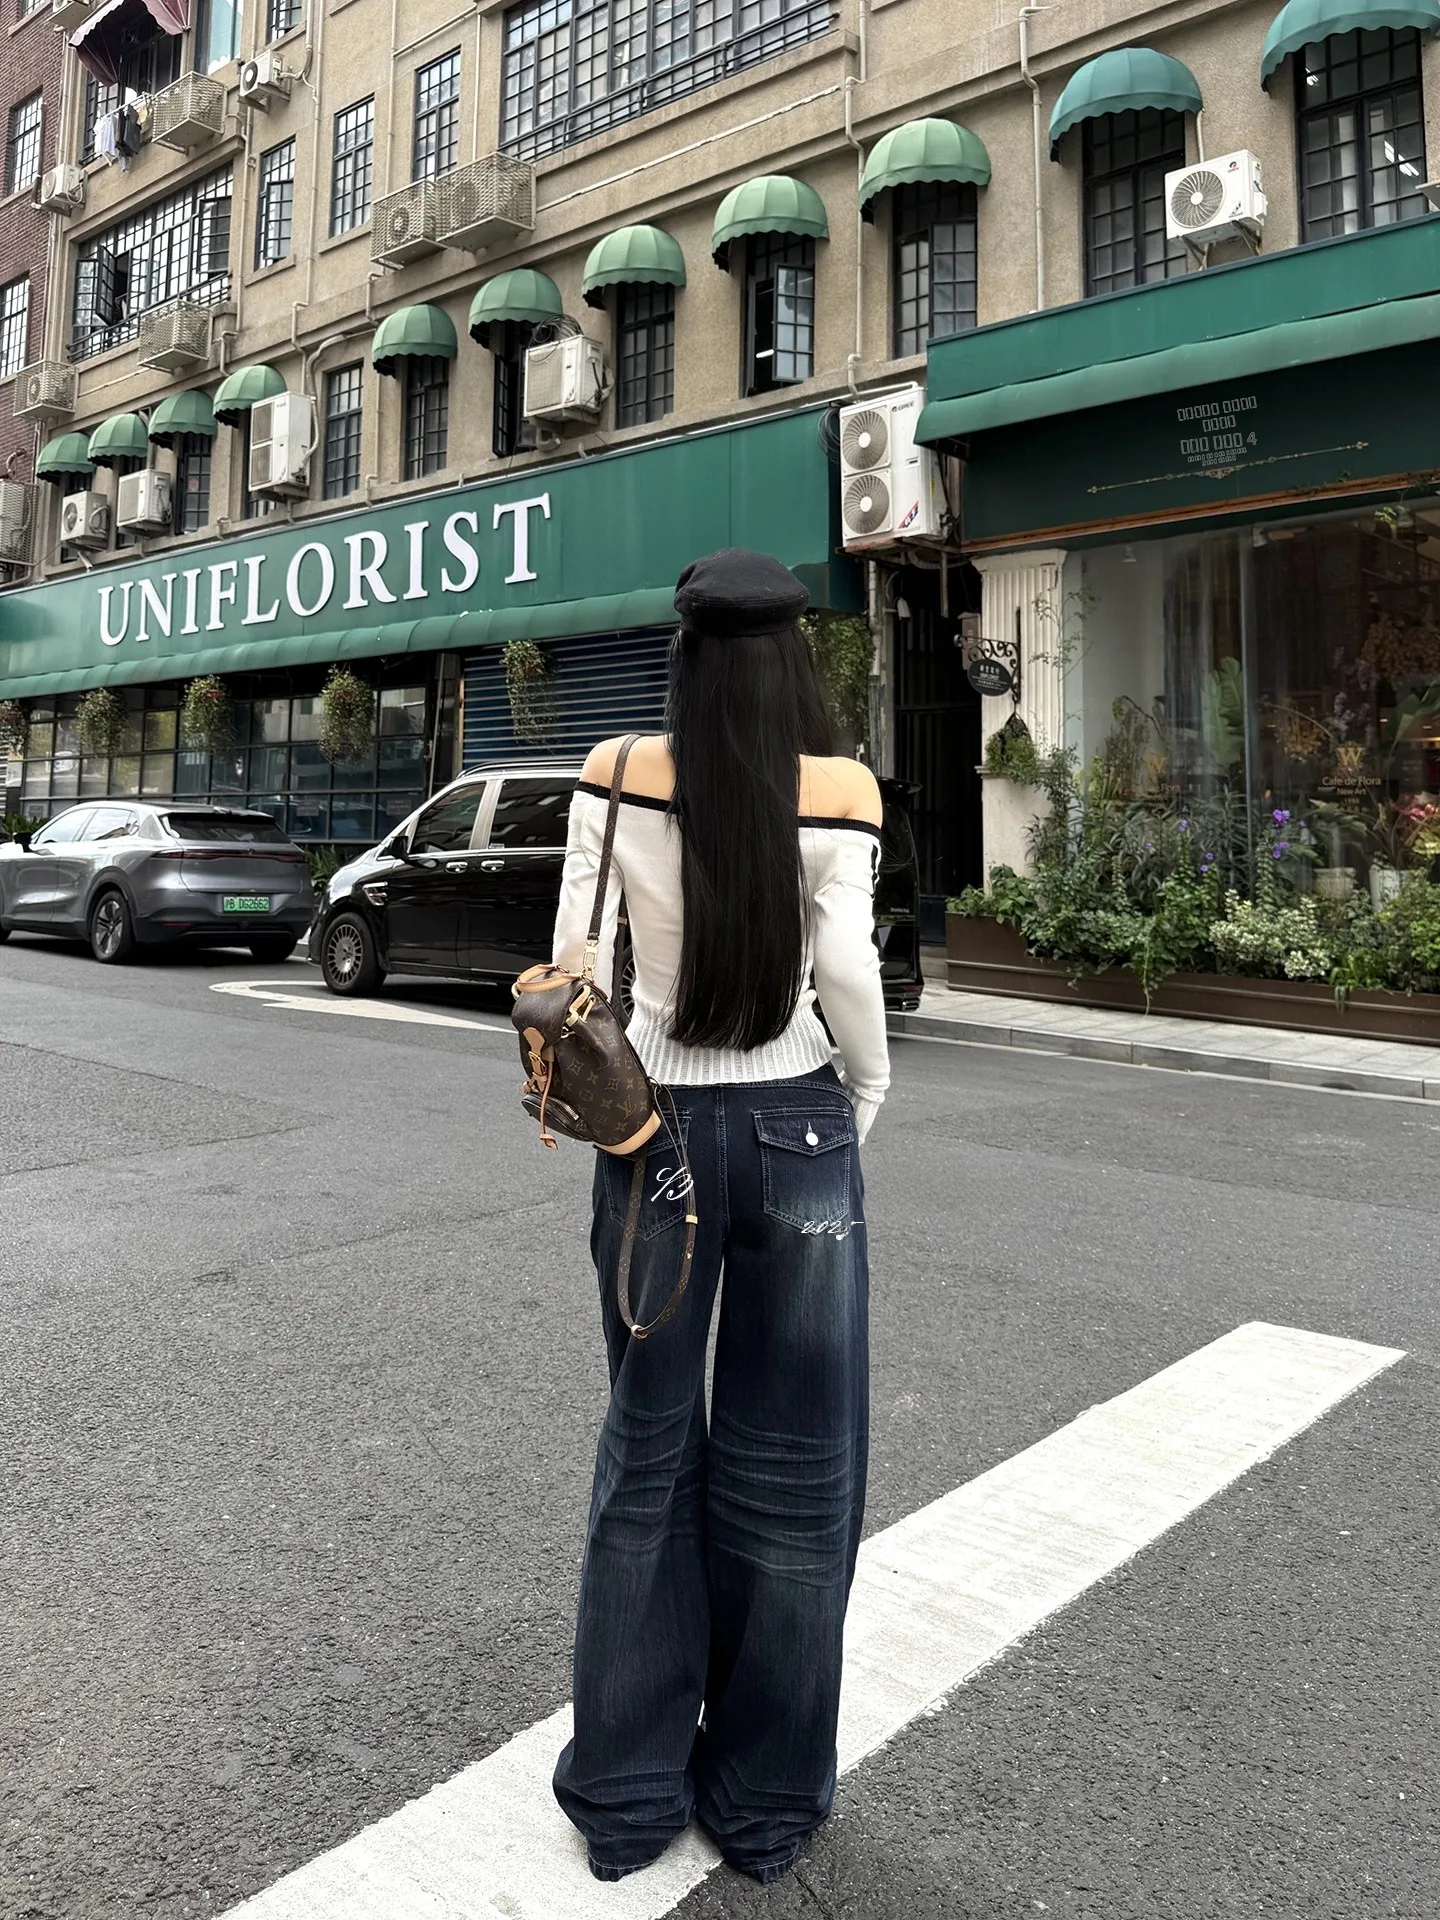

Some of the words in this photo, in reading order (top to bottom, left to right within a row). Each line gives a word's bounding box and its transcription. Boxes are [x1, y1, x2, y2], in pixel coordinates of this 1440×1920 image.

[98, 493, 551, 646] UNIFLORIST
[1344, 776, 1357, 786] de
[1358, 776, 1382, 786] Flora
